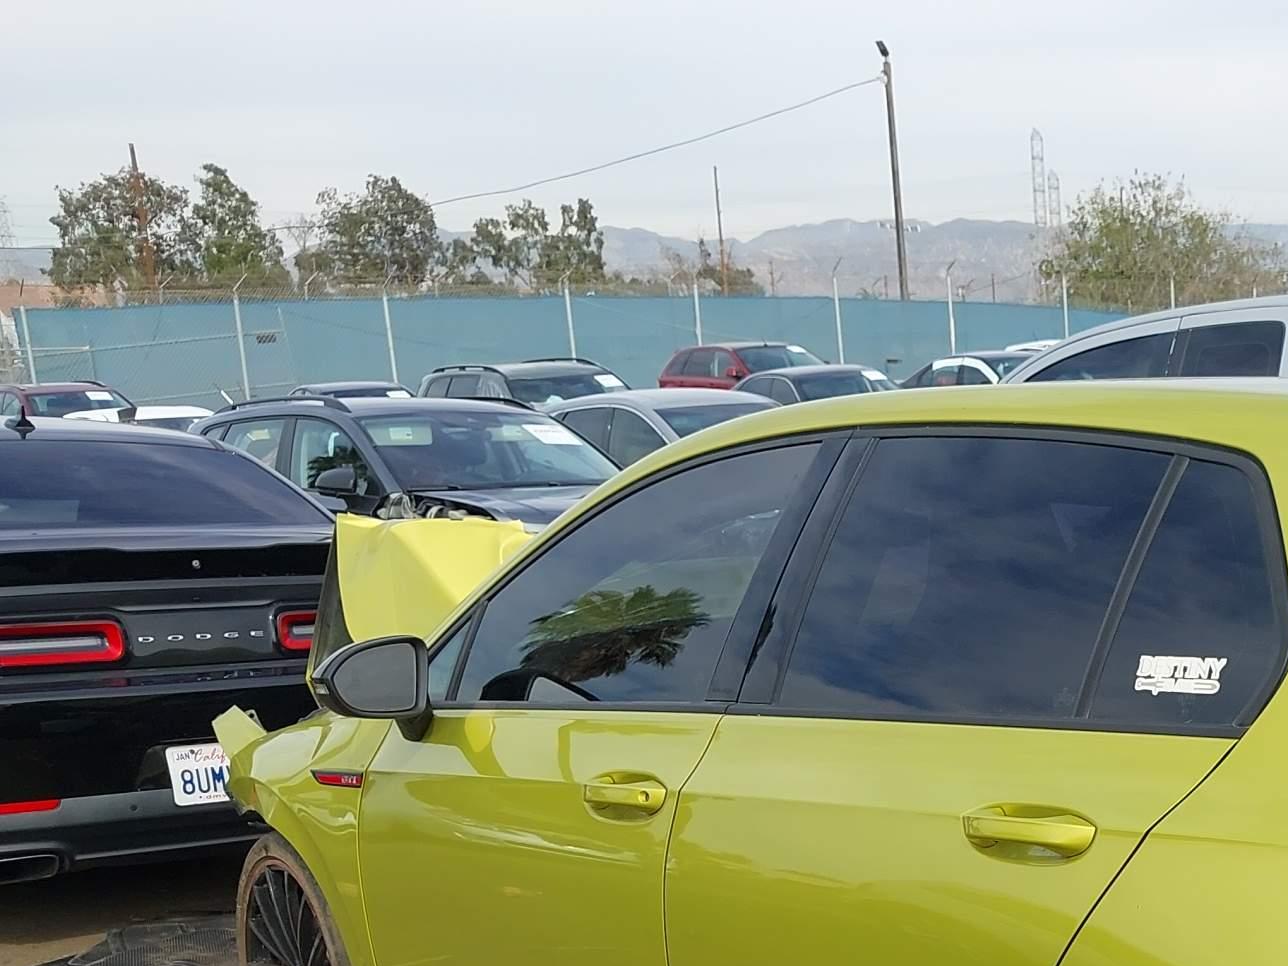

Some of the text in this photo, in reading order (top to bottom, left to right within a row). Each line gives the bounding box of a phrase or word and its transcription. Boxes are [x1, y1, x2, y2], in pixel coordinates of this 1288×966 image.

[138, 630, 264, 643] DODGE
[176, 751, 191, 761] JAN
[181, 765, 231, 795] 8UM
